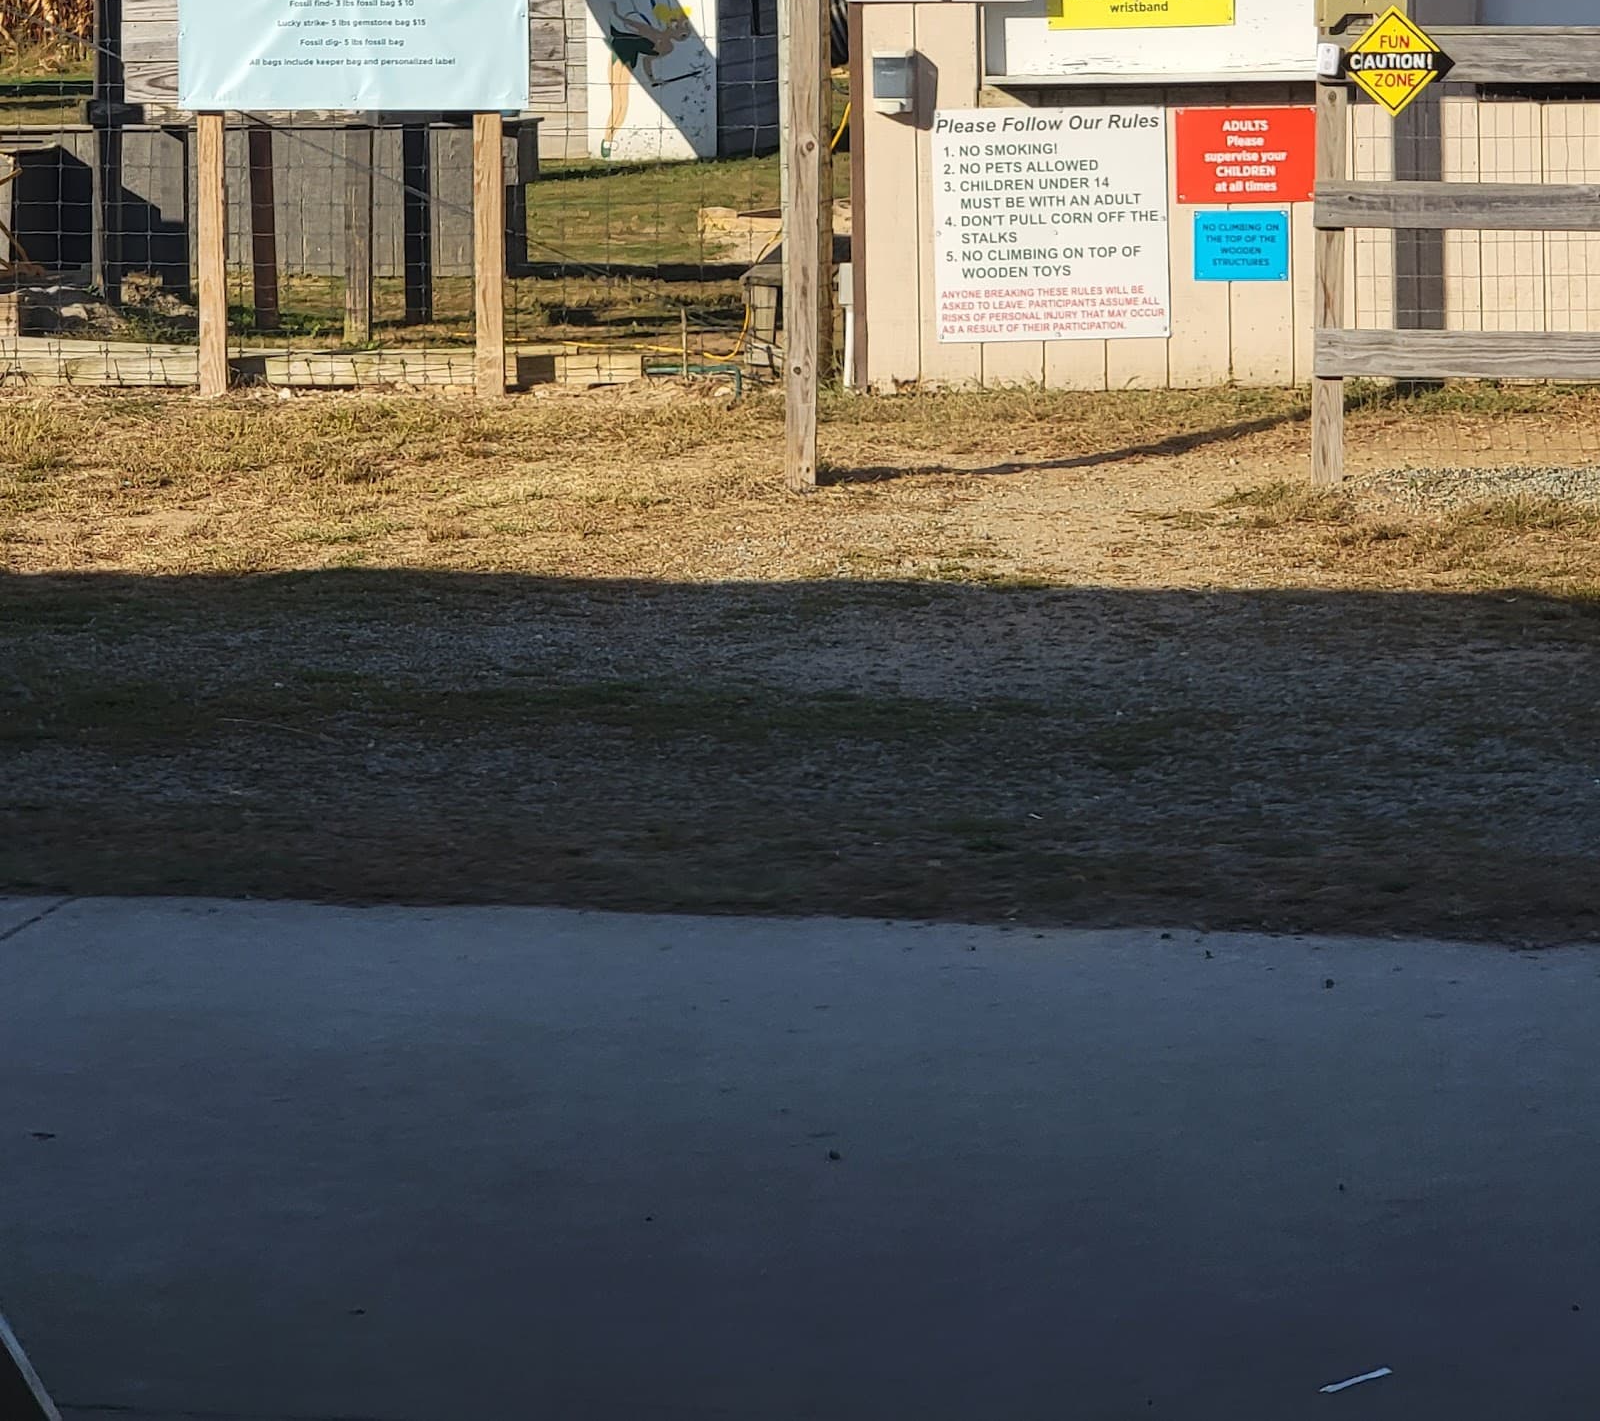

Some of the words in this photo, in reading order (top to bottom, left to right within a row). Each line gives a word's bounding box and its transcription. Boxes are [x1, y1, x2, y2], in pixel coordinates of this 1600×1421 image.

[1110, 1, 1168, 13] wristband
[1379, 35, 1410, 49] FUN
[436, 58, 455, 66] label
[1350, 52, 1432, 71] CAUTION!
[1374, 73, 1416, 88] ZONE
[936, 118, 996, 134] Please
[1002, 117, 1062, 132] Follow
[1069, 115, 1103, 130] Our
[1108, 114, 1159, 129] Rules
[1223, 120, 1269, 131] ADULTS
[1227, 136, 1264, 146] Please
[944, 147, 955, 157] 1.
[959, 145, 980, 157] NO
[985, 143, 1058, 156] SMOKING!
[1204, 151, 1259, 163] supervise
[1261, 151, 1287, 163] your
[944, 164, 955, 175] 2.
[960, 163, 981, 175] NO
[985, 161, 1022, 174] PETS
[1026, 159, 1099, 173] ALLOWED
[1216, 165, 1276, 177] CHILDREN
[944, 182, 956, 192] 3.
[960, 179, 1034, 192] CHILDREN
[1039, 177, 1089, 190] UNDER
[1095, 177, 1110, 188] 14
[1215, 182, 1227, 192] at
[1229, 181, 1243, 192] all
[1245, 181, 1277, 192] times
[961, 197, 1001, 210] MUST
[1005, 196, 1025, 208] BE
[1029, 195, 1066, 207] WITH
[1070, 194, 1089, 206] AN
[1094, 193, 1142, 205] ADULT
[945, 217, 957, 227] 4.
[961, 215, 1005, 227] DON'T
[1009, 213, 1047, 226] PULL
[1051, 212, 1093, 224] CORN
[1097, 211, 1125, 223] OFF
[1132, 210, 1158, 222] THE
[1219, 223, 1261, 231] CLIMBING
[1266, 223, 1279, 231] ON
[961, 232, 1017, 244] STALKS
[1207, 235, 1222, 243] THE
[1225, 235, 1242, 243] TOP
[1244, 235, 1256, 243] OF
[1260, 235, 1276, 243] THE
[946, 251, 957, 262] 5.
[962, 250, 983, 262] NO
[988, 248, 1058, 261] CLIMBING
[1063, 247, 1084, 259] ON
[1089, 246, 1117, 258] TOP
[1122, 246, 1141, 257] OF
[1212, 258, 1269, 266] STRUCTURES
[962, 266, 1028, 279] WOODEN
[1032, 265, 1072, 277] TOYS
[942, 290, 981, 299] ANYONE
[984, 288, 1034, 298] BREAKING
[1038, 287, 1069, 296] THESE
[1071, 286, 1102, 295] RULES
[1105, 286, 1128, 294] WILL
[1131, 285, 1144, 294] BE
[942, 301, 975, 311] ASKED
[978, 300, 990, 310] TO
[1029, 298, 1097, 308] PARTICIPANTS
[1100, 297, 1139, 306] ASSUME
[1142, 297, 1160, 306] ALL
[942, 312, 970, 322] RISKS
[973, 312, 986, 322] OF
[989, 311, 1041, 321] PERSONAL
[1044, 310, 1078, 319] INJURY
[1081, 309, 1104, 319] THAT
[1107, 309, 1127, 318] MAY
[1130, 308, 1164, 317] OCCUR
[943, 324, 955, 334] AS
[958, 324, 964, 334] A
[967, 324, 1004, 333] RESULT
[1007, 323, 1020, 333] OF
[1022, 323, 1050, 332] THEIR
[1053, 321, 1126, 331] PARTICIPATION.
